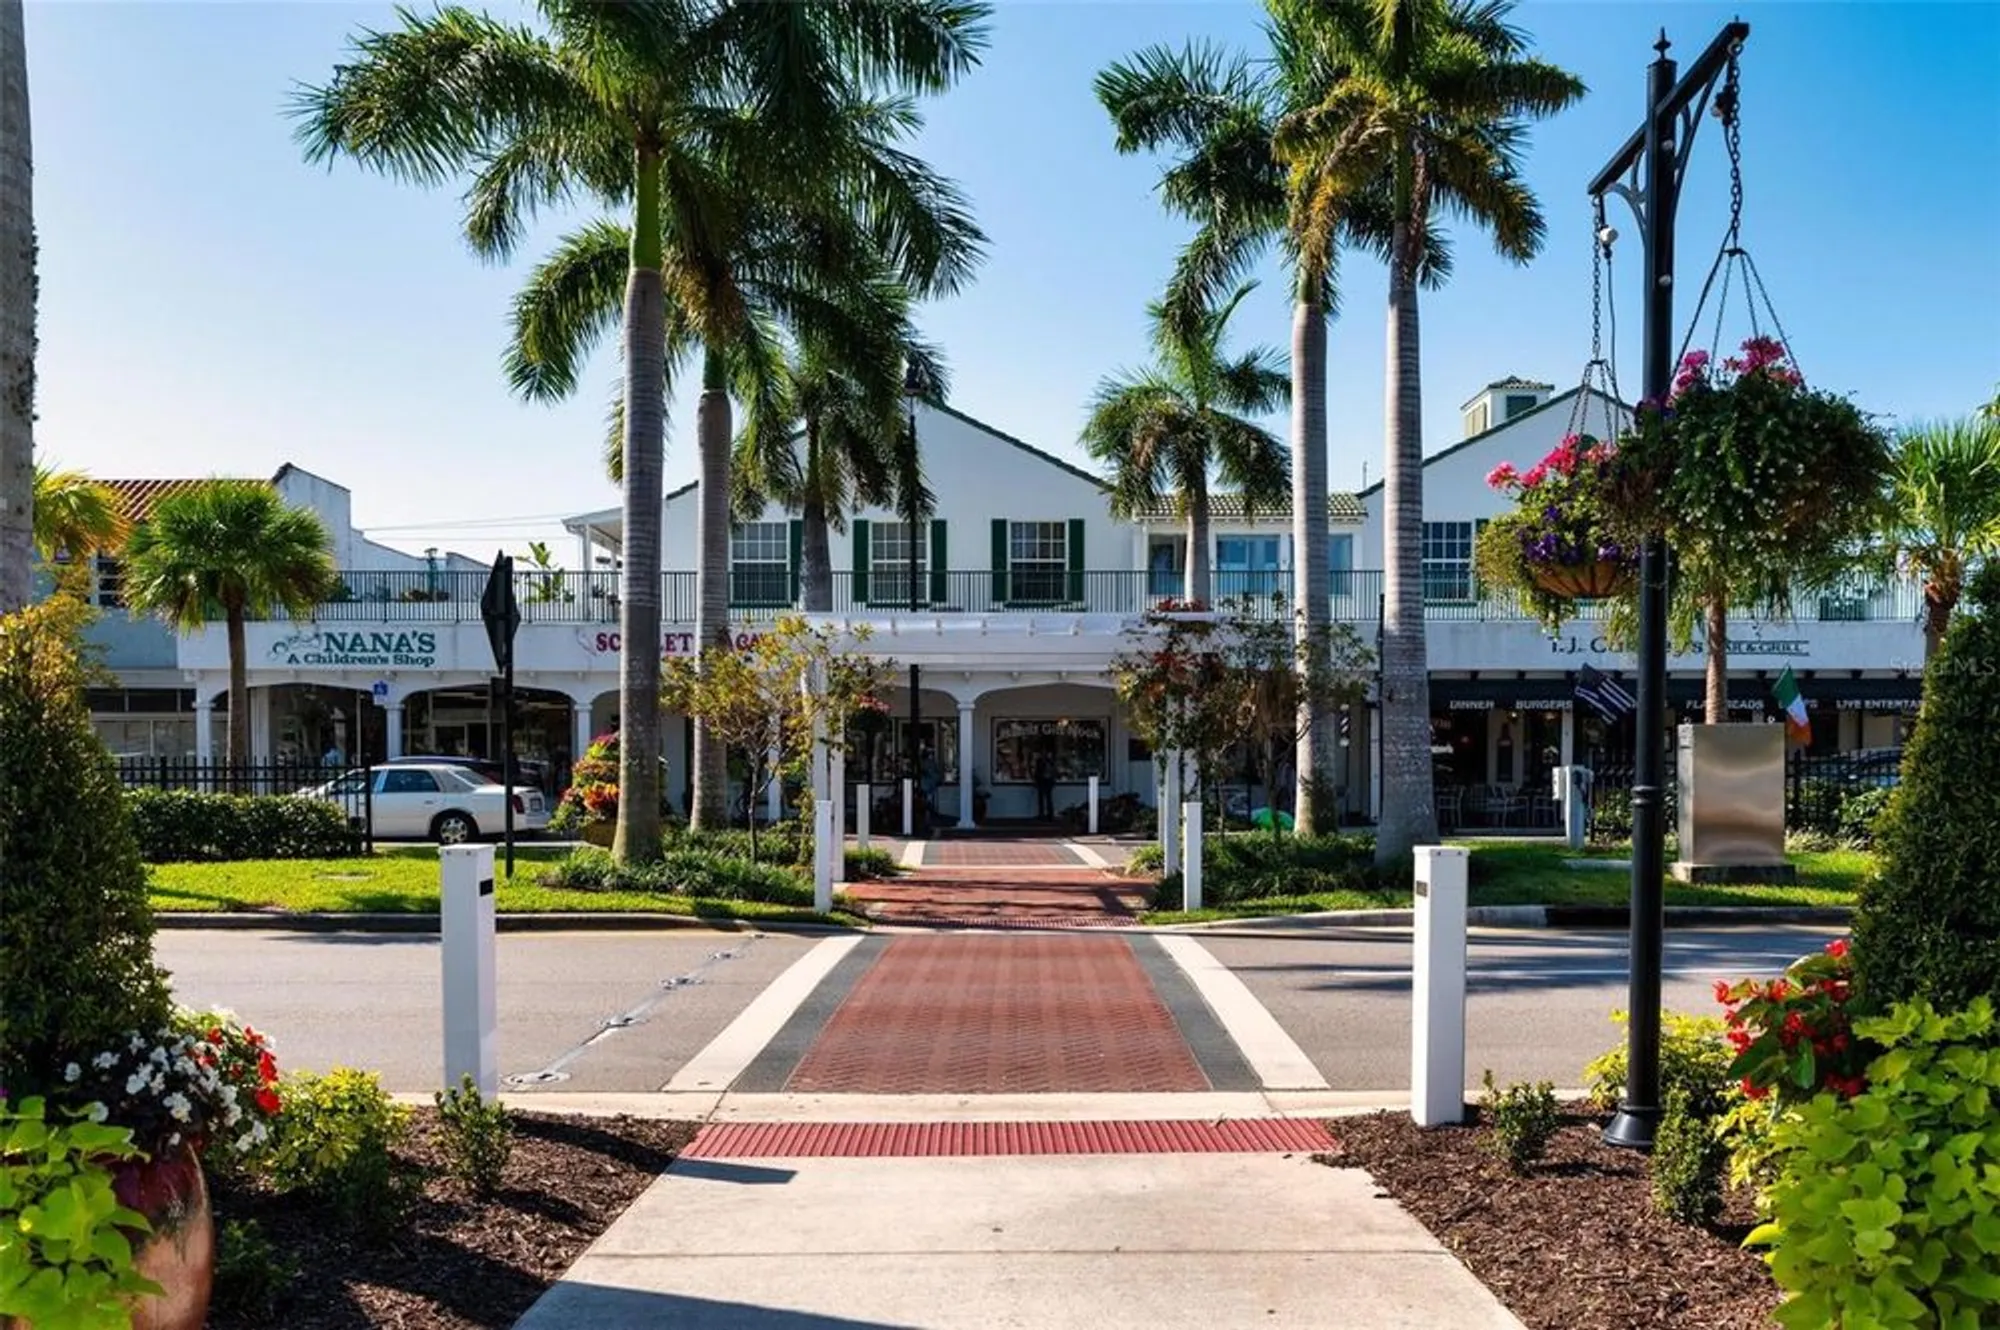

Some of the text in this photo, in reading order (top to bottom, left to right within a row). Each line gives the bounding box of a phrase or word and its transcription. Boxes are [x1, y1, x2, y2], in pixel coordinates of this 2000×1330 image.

[324, 631, 436, 653] NANA'S
[595, 632, 694, 651] SCET
[287, 653, 435, 667] A Children's Shop
[1449, 699, 1496, 710] DINNER
[1515, 699, 1574, 710] BURGERS
[1836, 699, 1862, 710] LIVE
